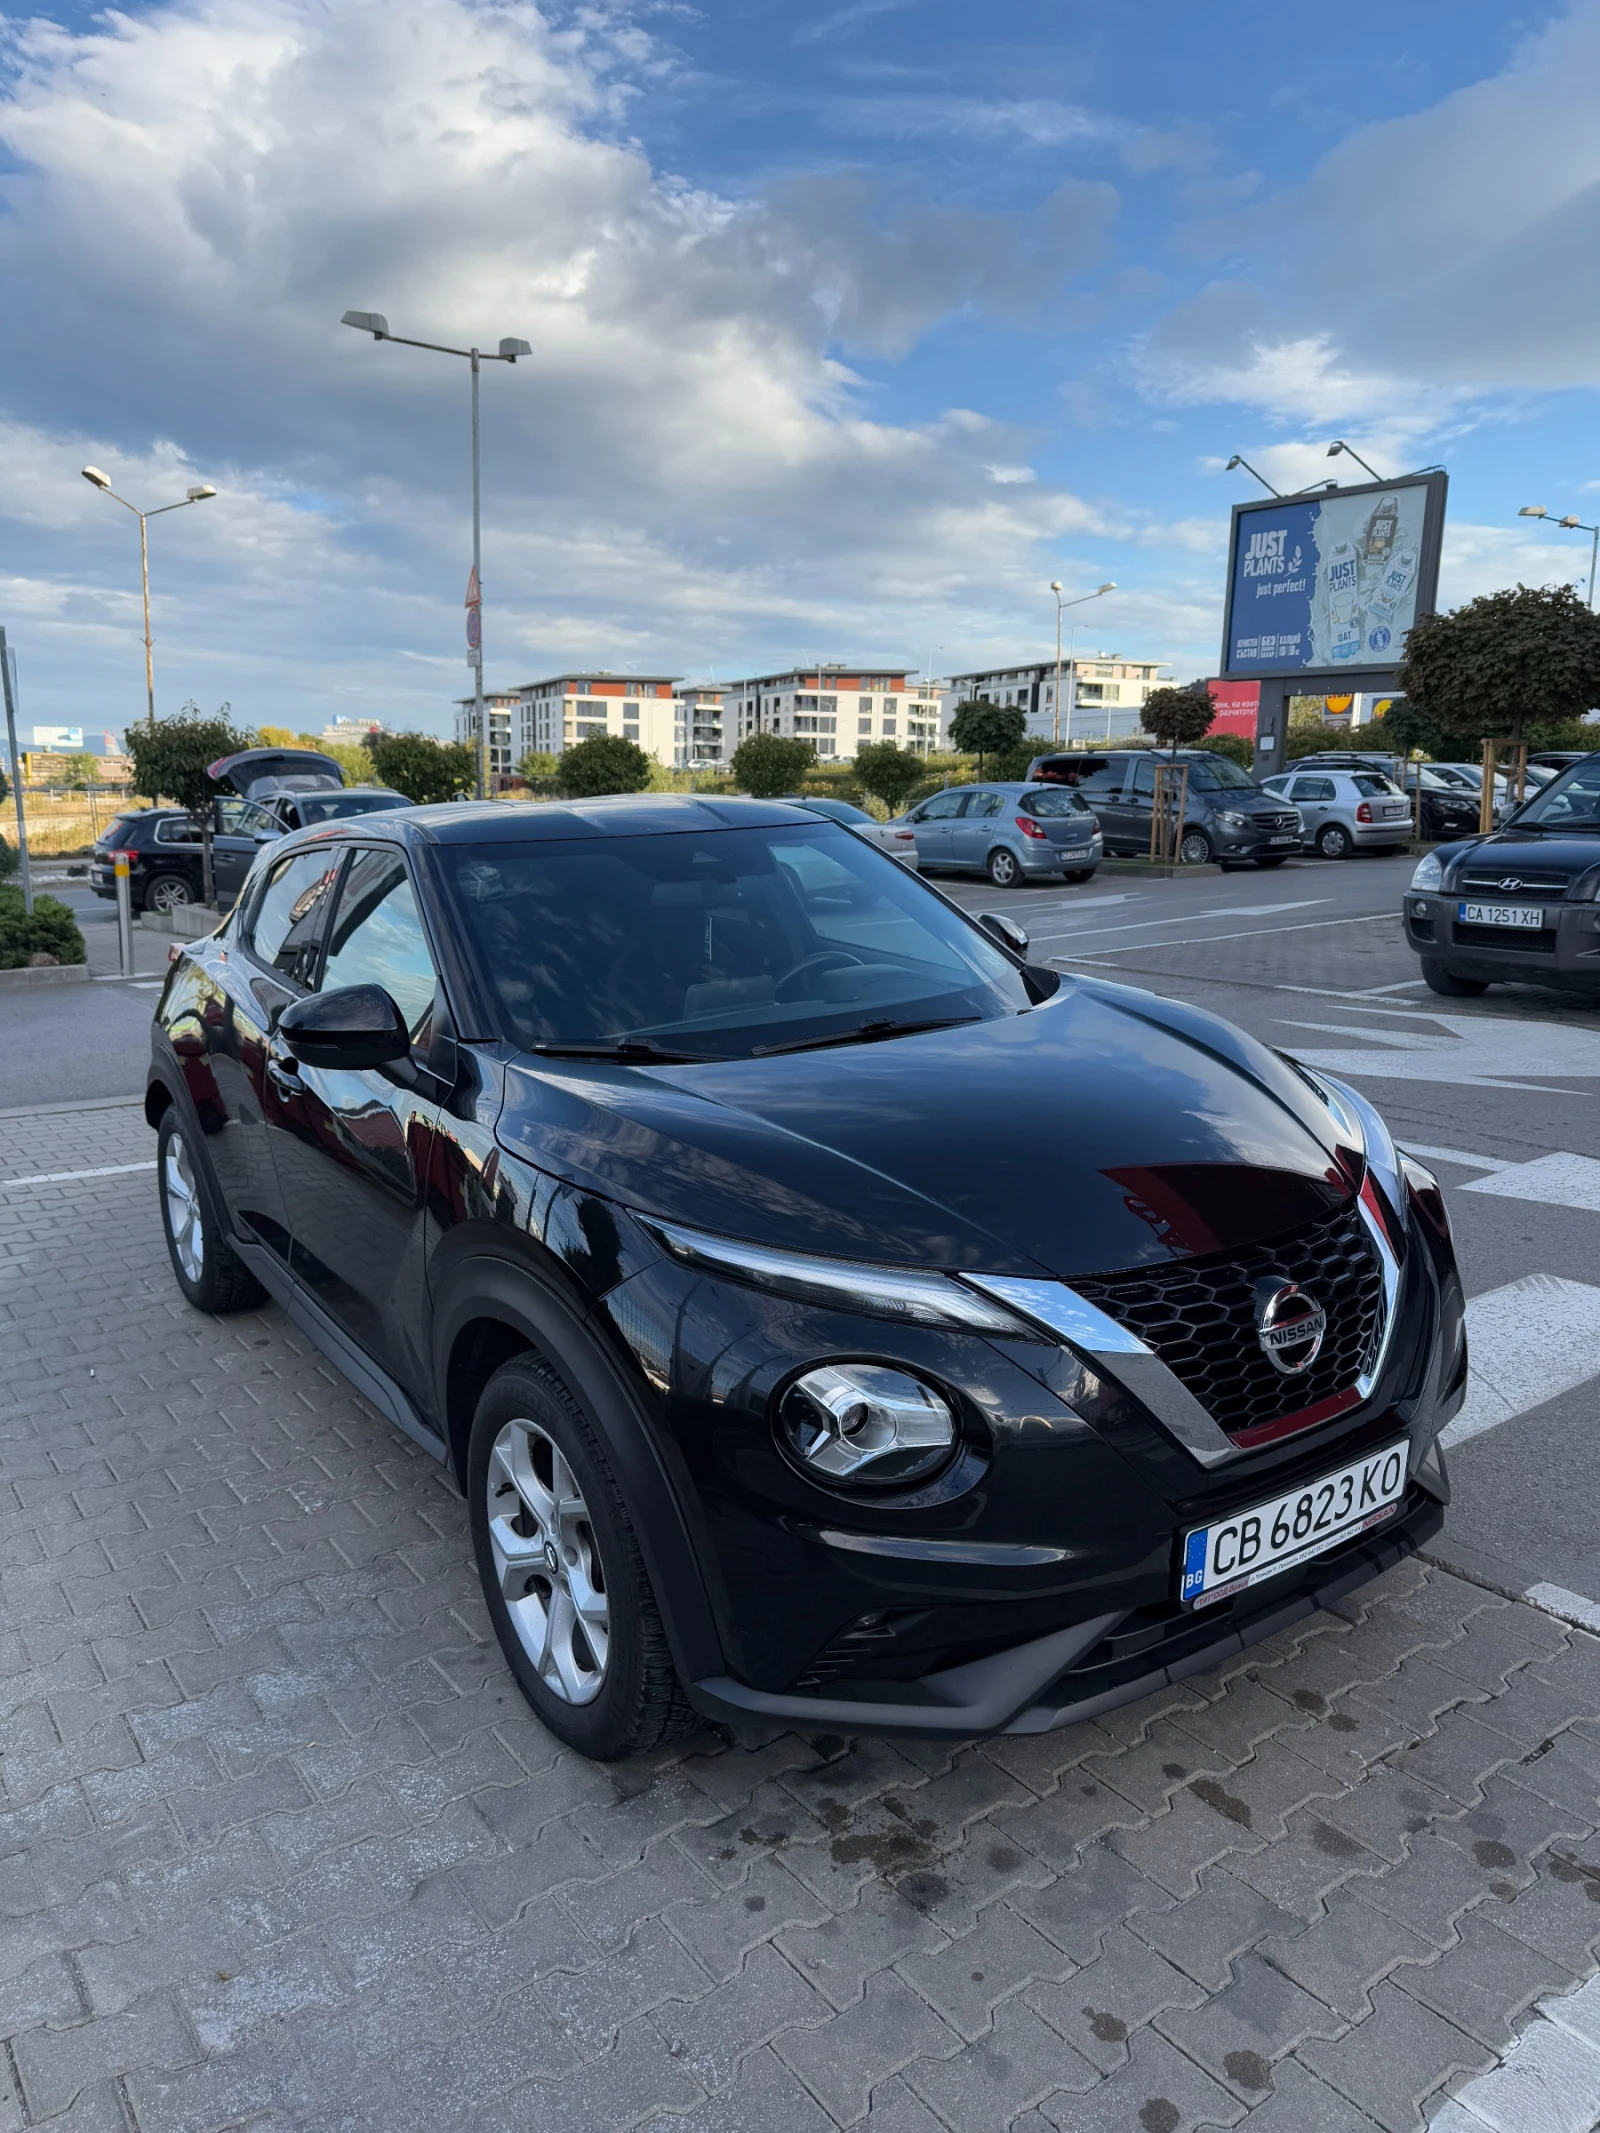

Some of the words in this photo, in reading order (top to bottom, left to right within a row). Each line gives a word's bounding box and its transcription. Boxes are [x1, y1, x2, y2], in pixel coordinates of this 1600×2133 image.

[1371, 526, 1391, 537] PLANTS
[1374, 519, 1394, 530] JUST
[1244, 529, 1288, 560] JUST
[1243, 555, 1285, 578] PLANTS
[1329, 560, 1355, 582] JUST
[1329, 575, 1357, 593] PLANTS
[1384, 578, 1403, 592] PLANTS
[1388, 570, 1407, 585] JUST
[1255, 580, 1272, 599] just
[1272, 577, 1306, 595] perfect!
[1261, 635, 1276, 647] БЕЗ
[1279, 632, 1301, 645] КАЛЦИЙ
[1338, 631, 1352, 642] OAT
[1236, 647, 1258, 659] СЪСТАВ
[1219, 707, 1257, 718] разчитате!
[1231, 701, 1241, 709] на
[1467, 906, 1483, 921] CA
[1488, 908, 1517, 923] 1251
[1521, 910, 1540, 925] XH
[1270, 1315, 1323, 1346] NISSAN
[1213, 1517, 1261, 1576] CB
[1270, 1474, 1354, 1550] 6823
[1359, 1452, 1401, 1510] KO
[1361, 1504, 1396, 1530] NISSAN
[1185, 1569, 1203, 1589] BG
